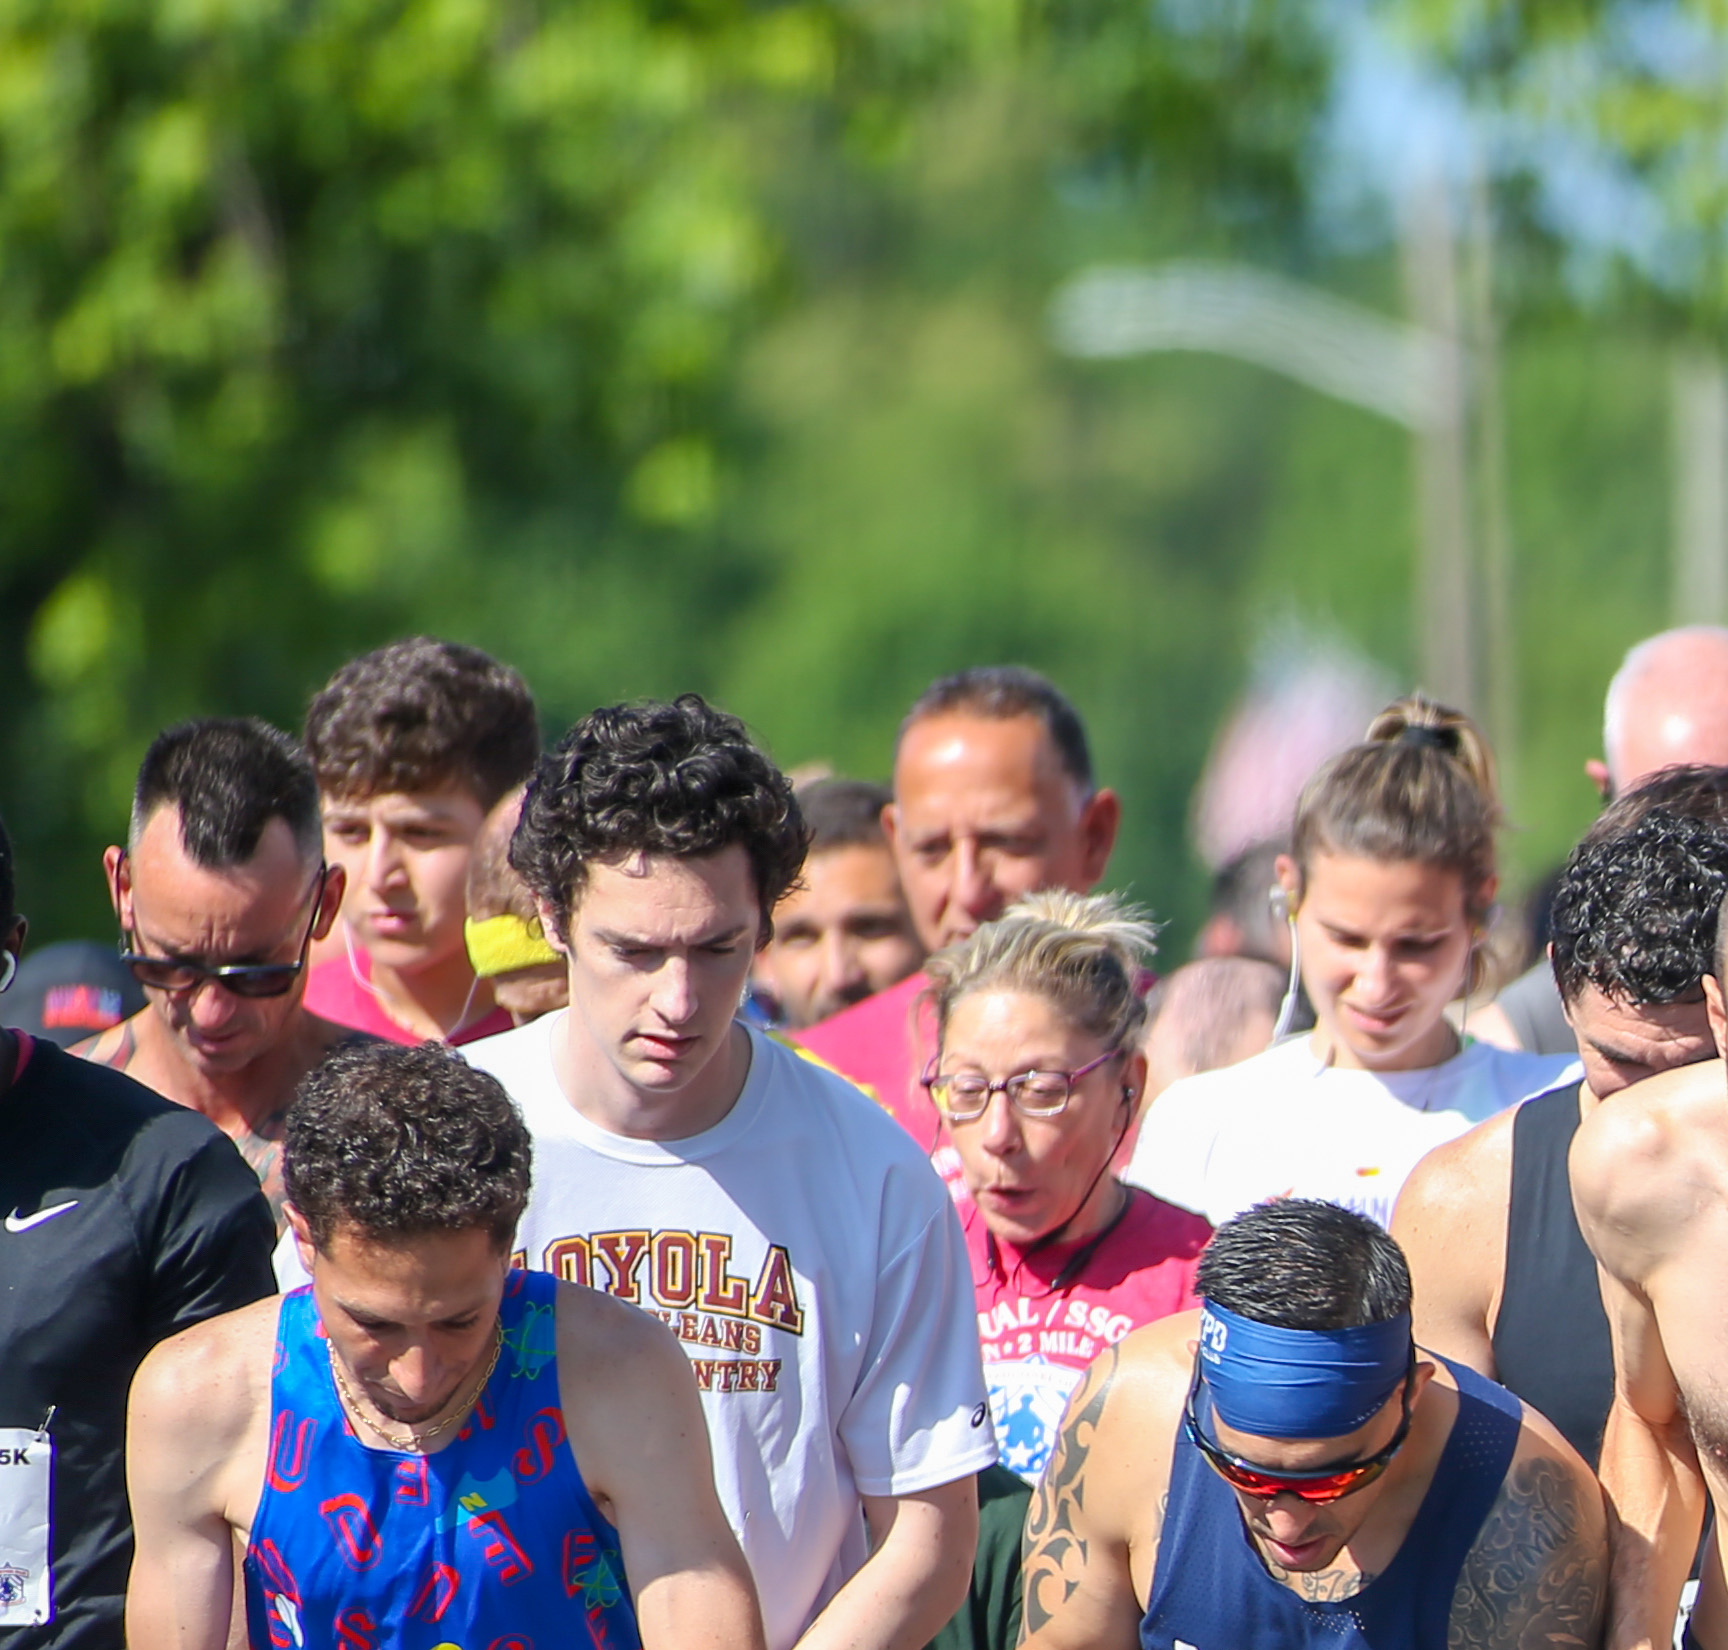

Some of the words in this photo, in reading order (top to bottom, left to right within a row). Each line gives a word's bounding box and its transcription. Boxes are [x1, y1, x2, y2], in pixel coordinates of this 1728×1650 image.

[510, 1228, 805, 1337] OYOLA
[648, 1309, 762, 1356] LEANS
[977, 1297, 1040, 1340] UAL
[1064, 1299, 1134, 1344] SSG
[1038, 1330, 1096, 1358] MILE
[692, 1358, 783, 1393] NTRY
